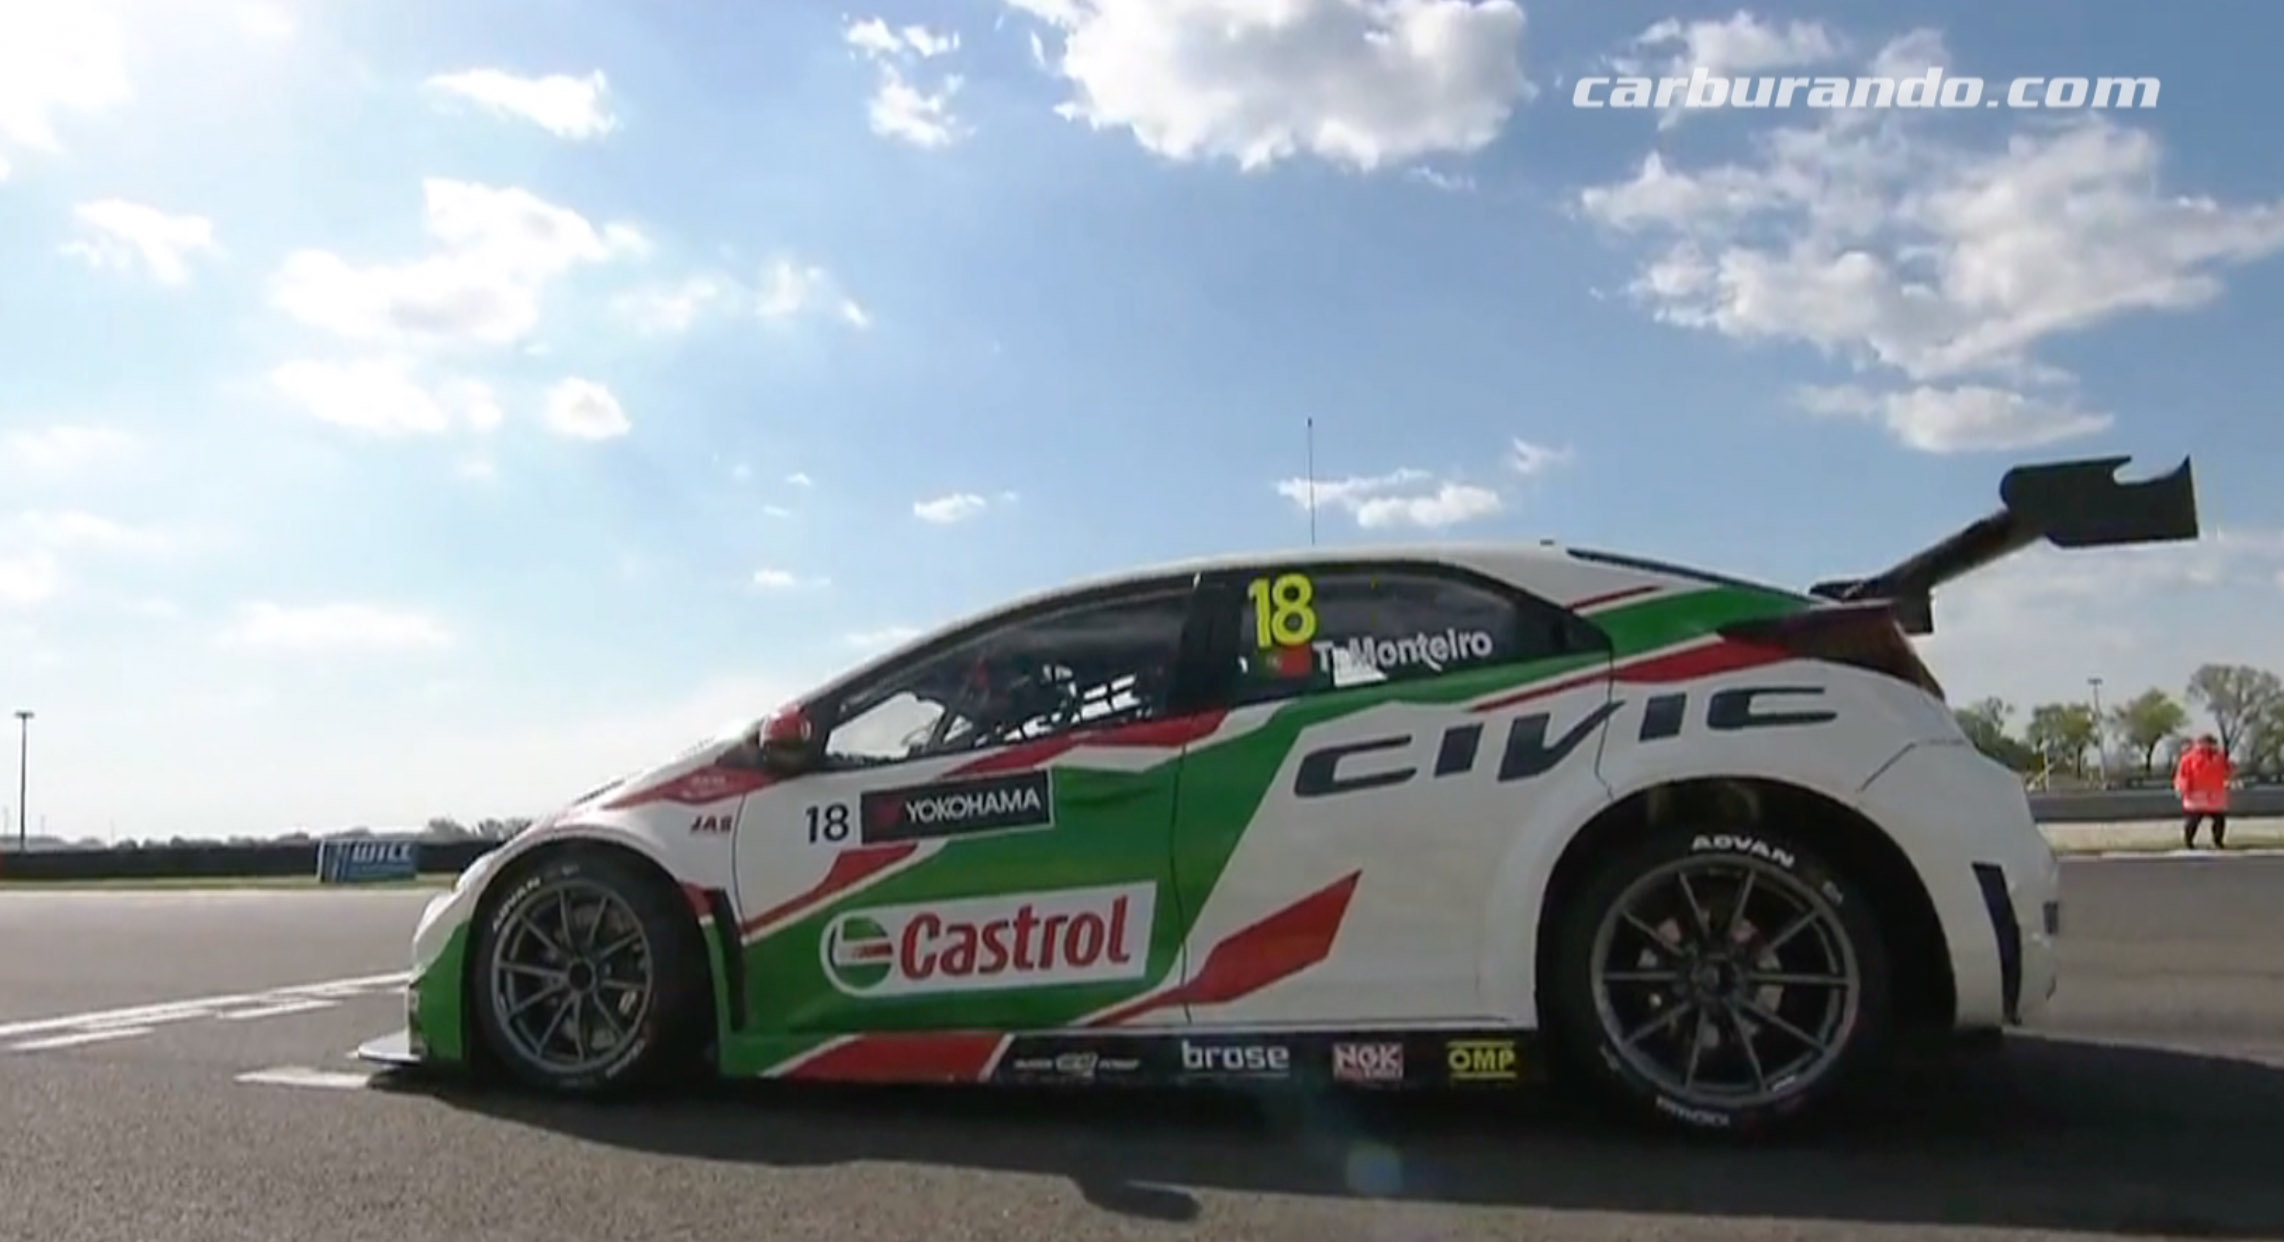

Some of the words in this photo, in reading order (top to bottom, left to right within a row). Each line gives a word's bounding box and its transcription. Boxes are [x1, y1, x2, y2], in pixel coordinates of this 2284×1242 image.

[1247, 573, 1317, 648] 18
[1293, 686, 1838, 798] CIVIC
[804, 804, 850, 844] 18
[905, 787, 1042, 823] YOKOHAMA
[1691, 834, 1795, 868] ADVAN
[900, 895, 1131, 981] Castrol
[1181, 1039, 1290, 1070] brose
[1448, 1045, 1516, 1072] OMP
